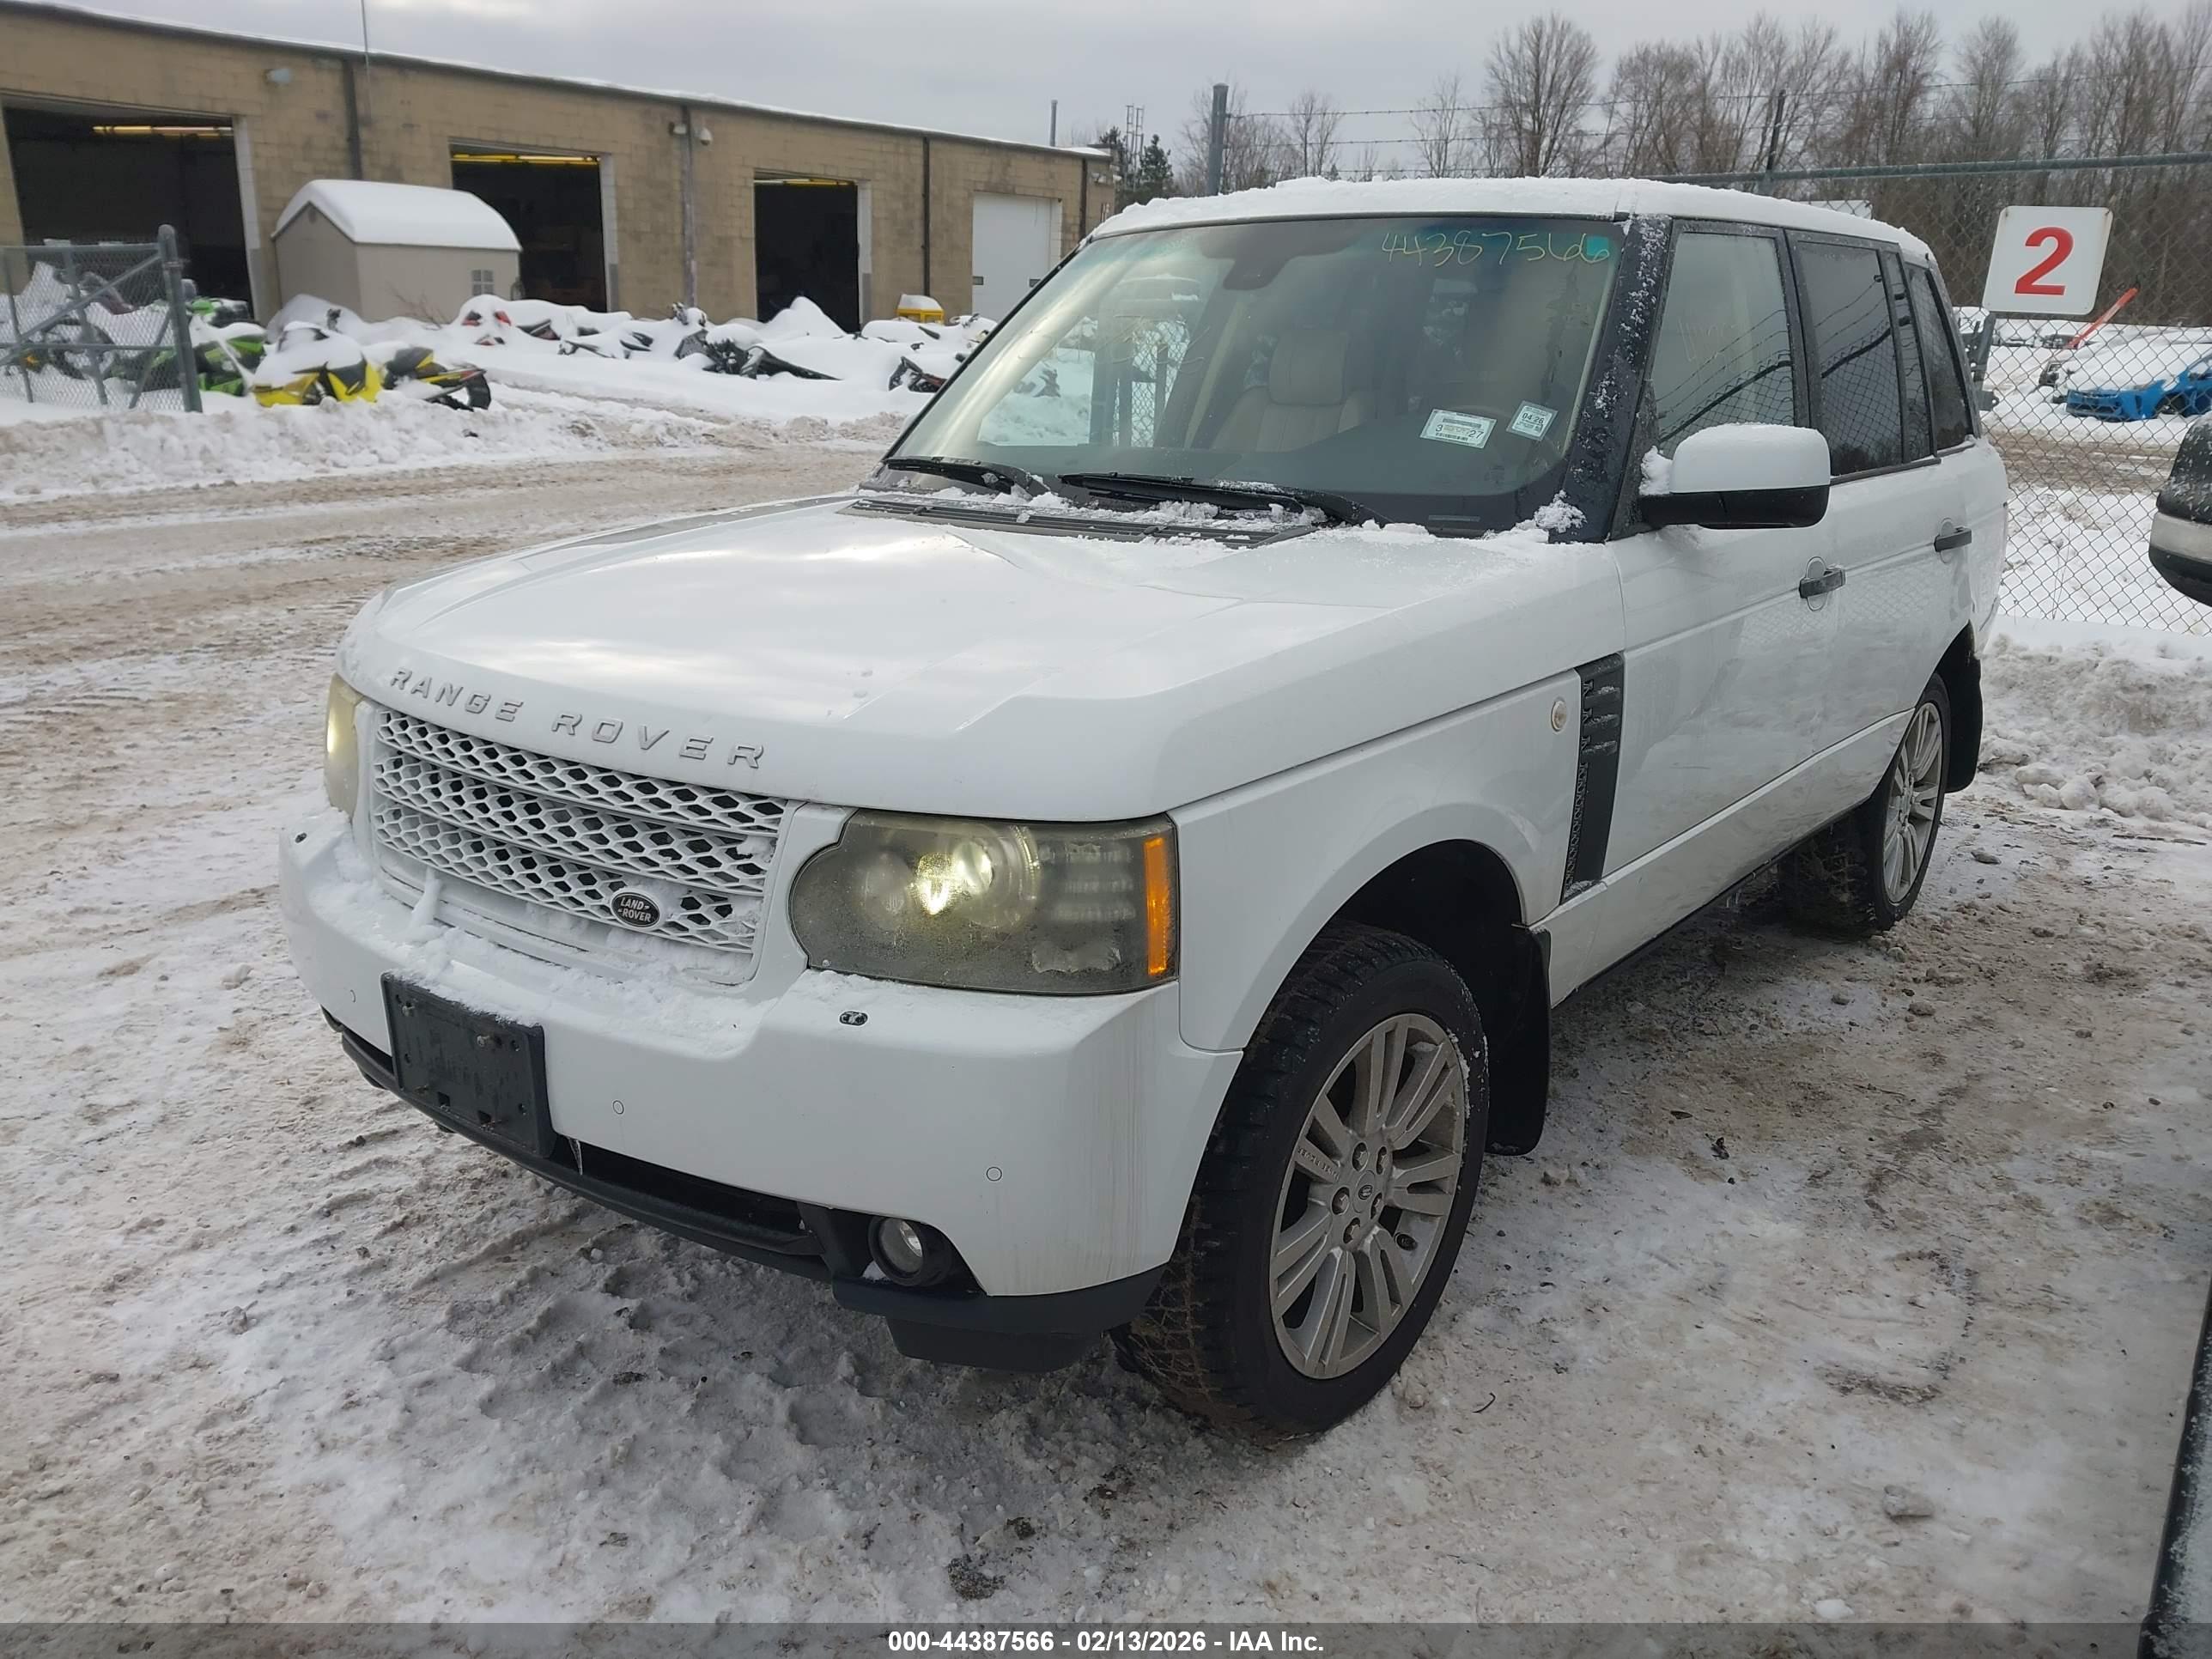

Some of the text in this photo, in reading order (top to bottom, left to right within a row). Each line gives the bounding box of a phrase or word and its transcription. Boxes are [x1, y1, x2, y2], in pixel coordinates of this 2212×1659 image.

[2014, 226, 2075, 295] 2
[389, 666, 764, 769] RANGE ROVER
